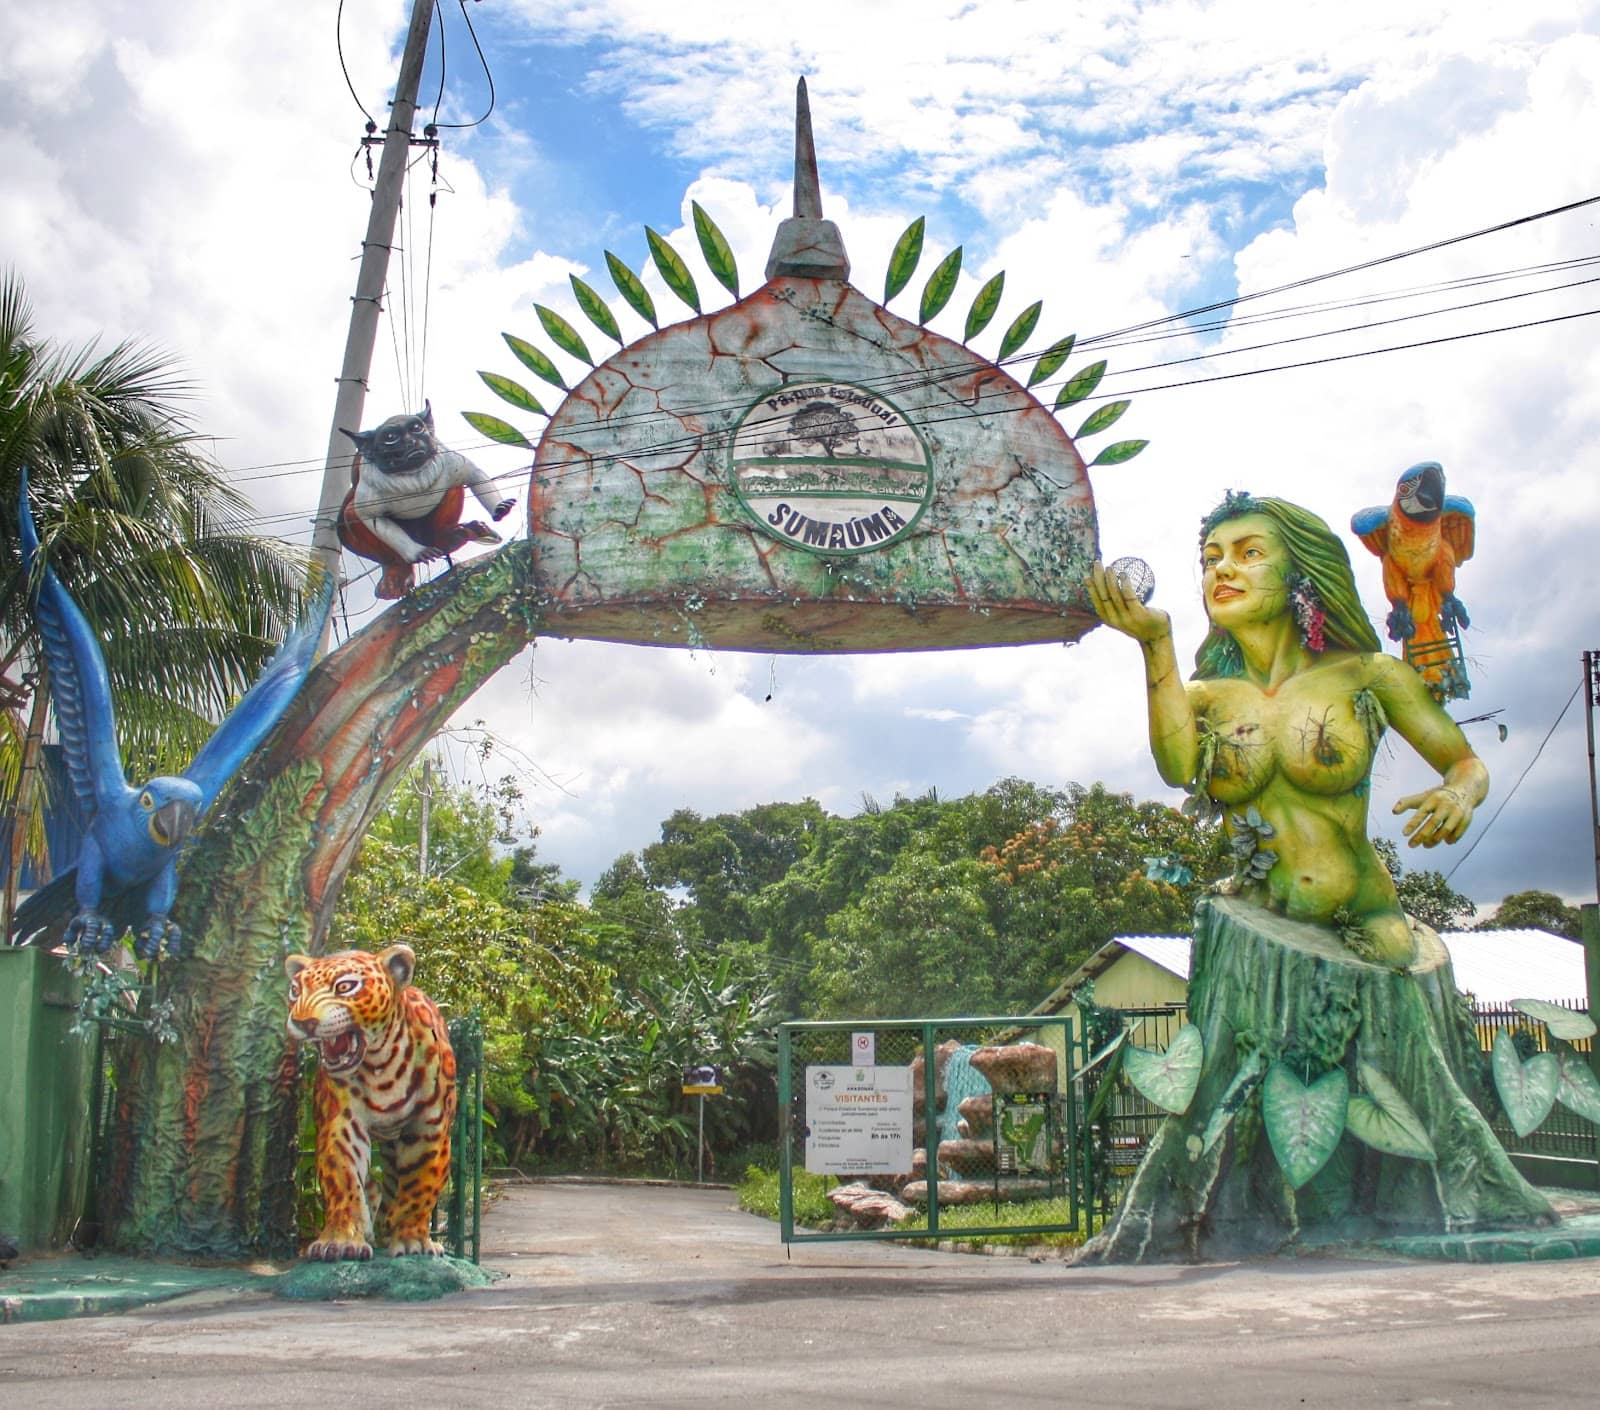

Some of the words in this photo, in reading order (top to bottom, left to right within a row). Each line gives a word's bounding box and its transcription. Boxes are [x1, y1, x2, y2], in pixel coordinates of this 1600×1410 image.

[830, 386, 898, 426] Estadual
[767, 503, 907, 549] SUMAÚMA
[835, 1094, 889, 1103] VISITANTES
